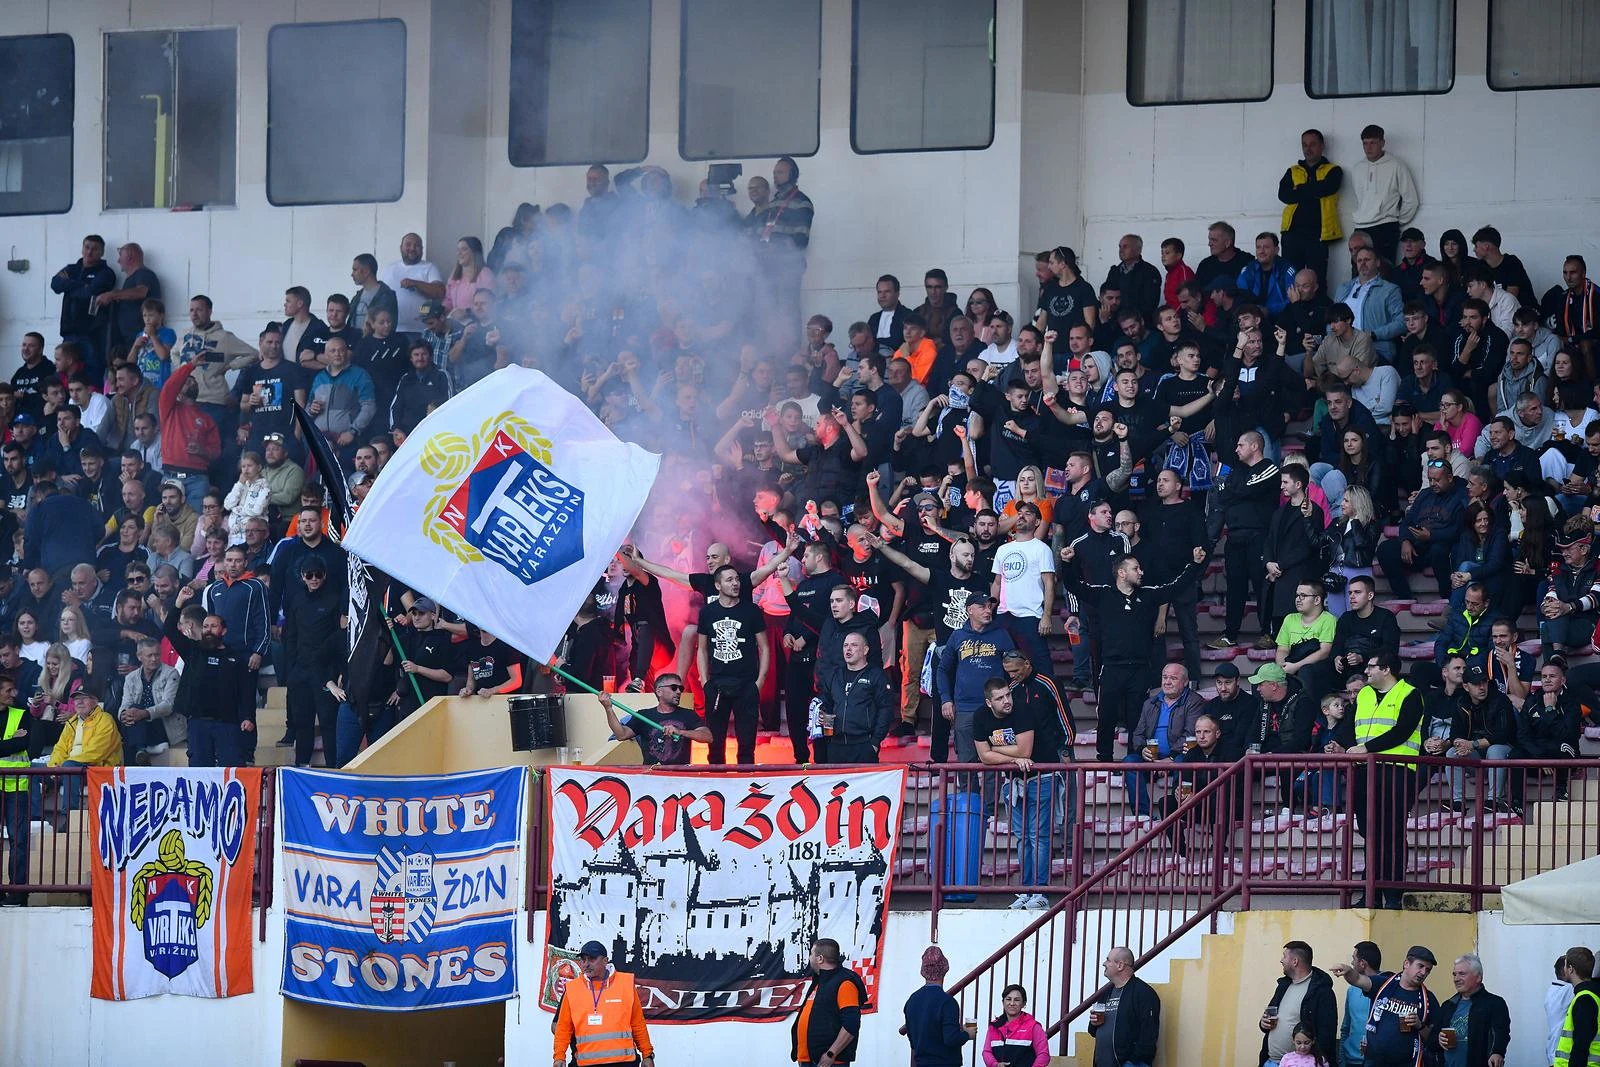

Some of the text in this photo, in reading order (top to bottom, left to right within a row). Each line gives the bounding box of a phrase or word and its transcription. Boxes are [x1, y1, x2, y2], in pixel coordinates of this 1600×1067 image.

[470, 460, 571, 568] VARTEKS
[1004, 561, 1022, 571] BKD
[100, 777, 246, 870] NEDAMO
[310, 790, 496, 837] WHITE
[554, 776, 892, 852] Varaždin
[788, 842, 822, 862] 1181
[295, 865, 506, 912] VARA ŽDIN
[291, 942, 508, 992] STONES
[635, 980, 812, 1010] NITE
